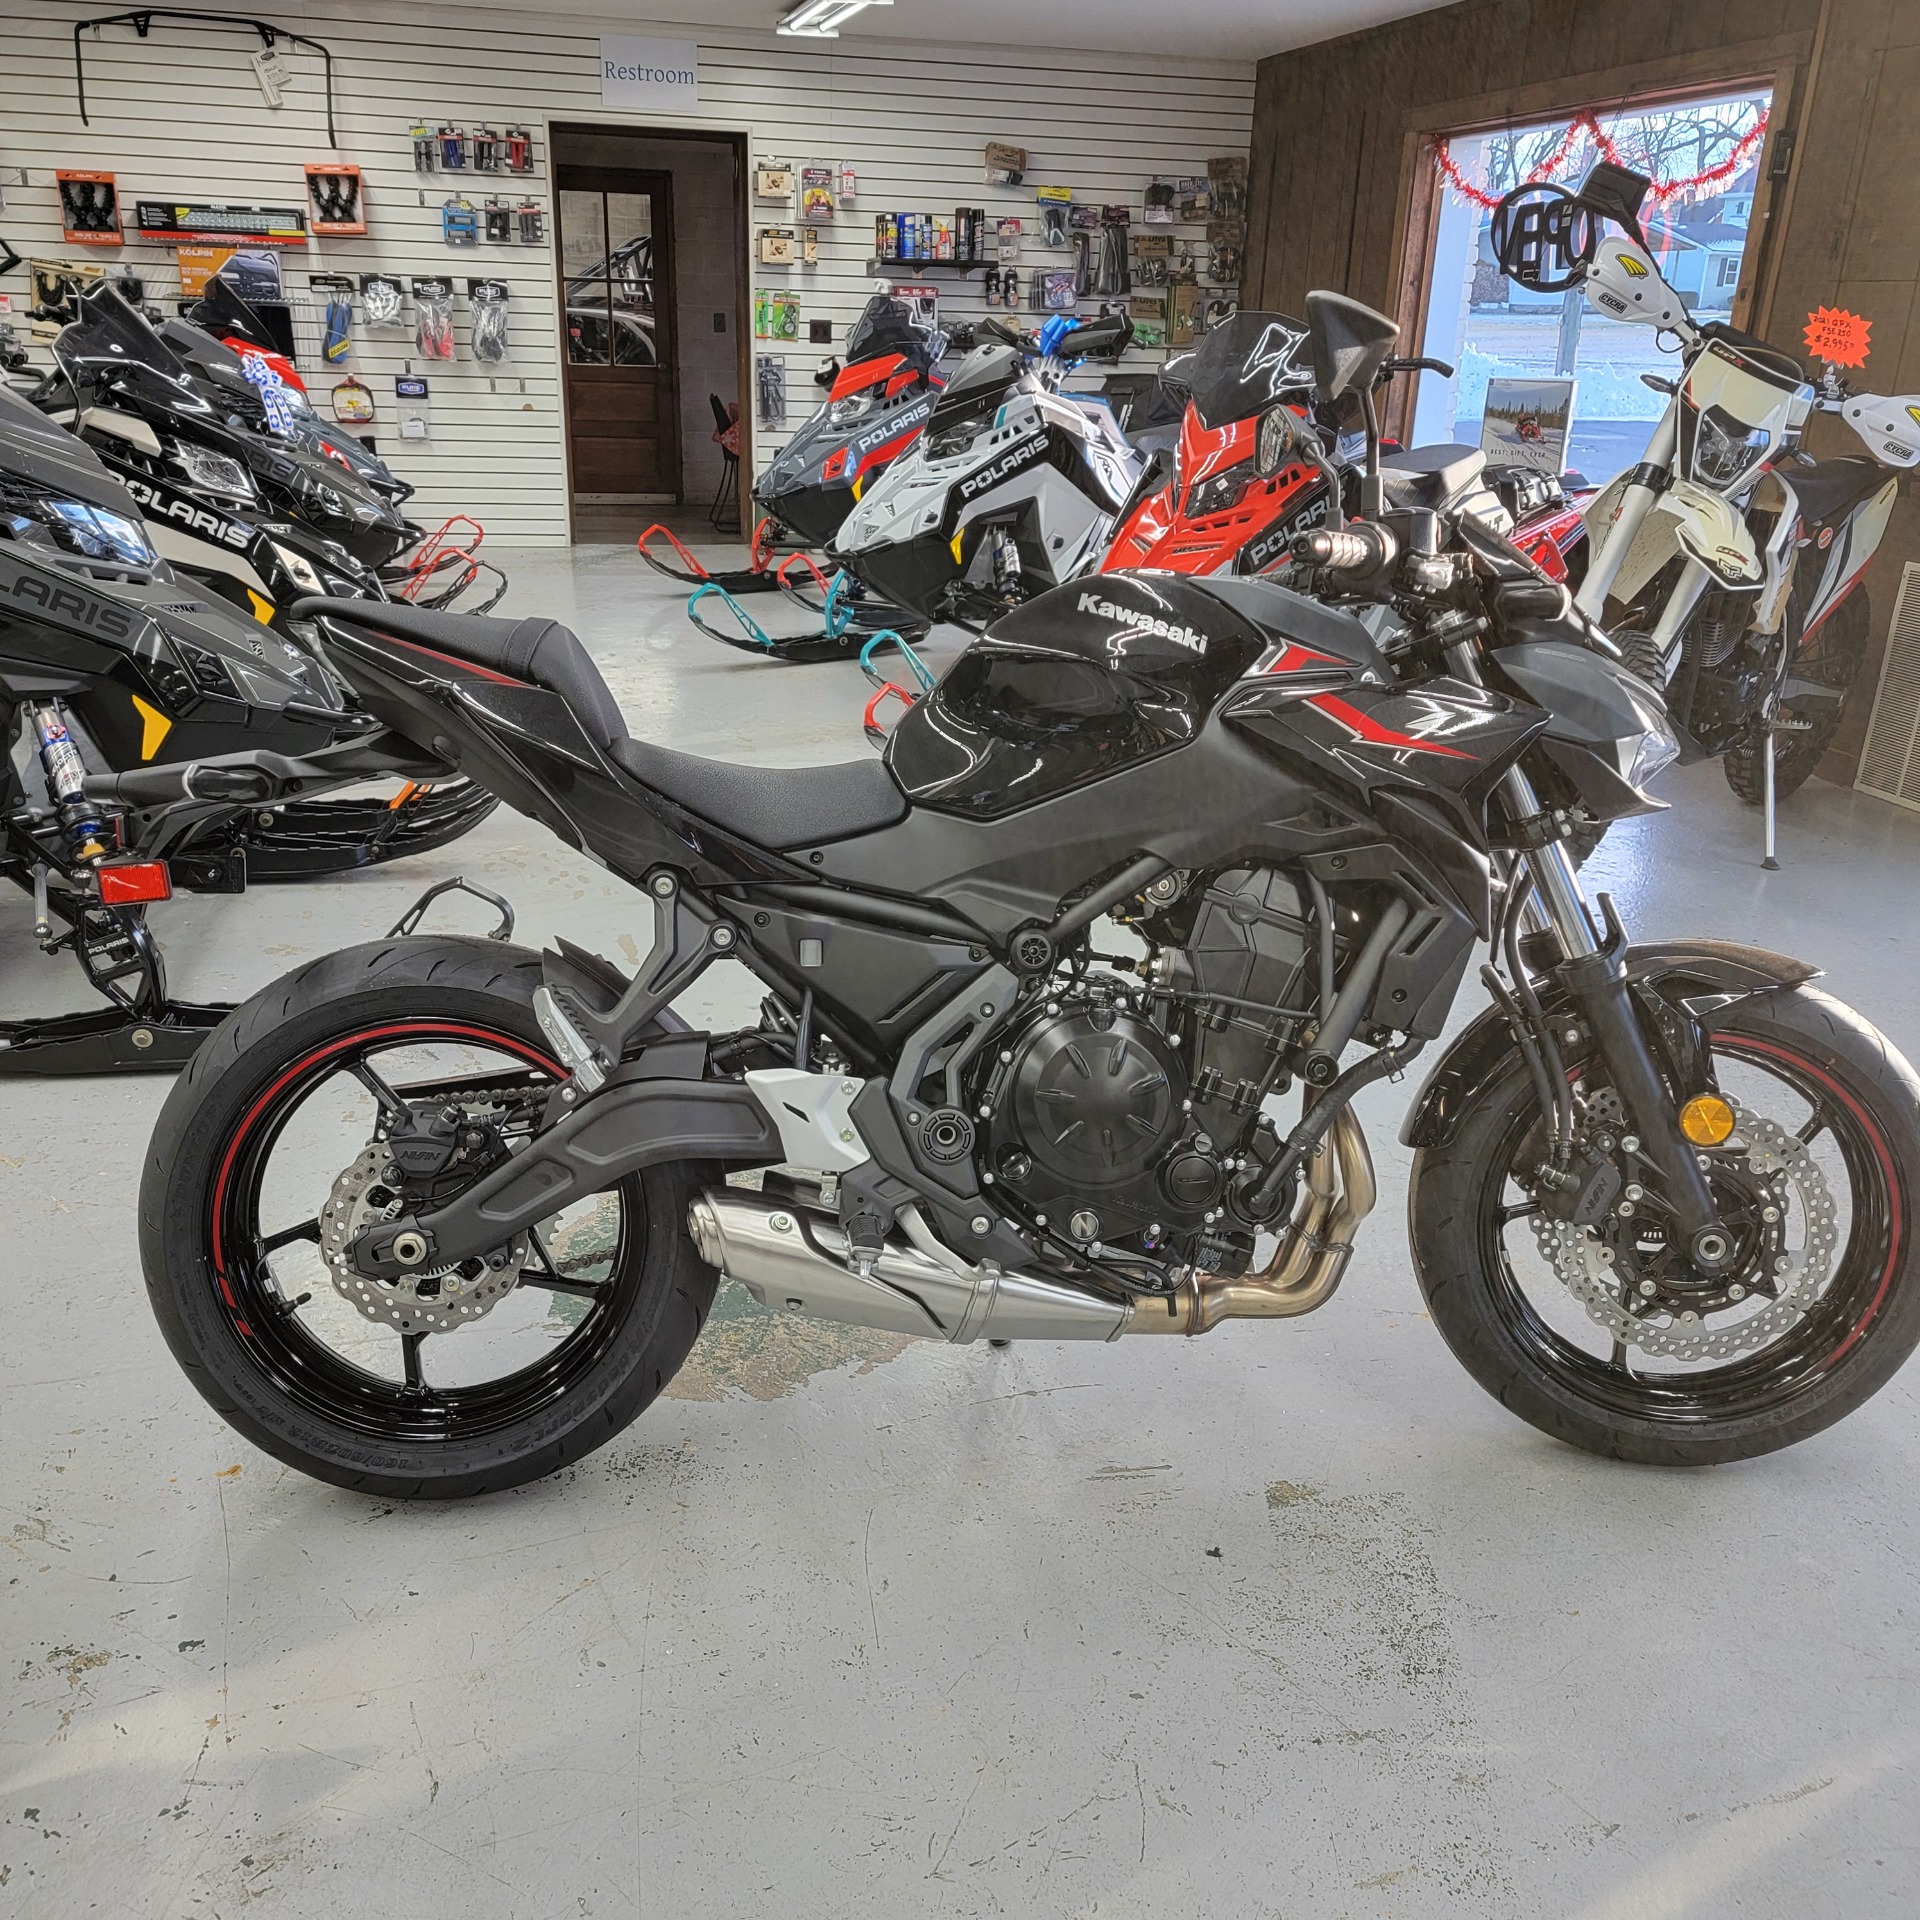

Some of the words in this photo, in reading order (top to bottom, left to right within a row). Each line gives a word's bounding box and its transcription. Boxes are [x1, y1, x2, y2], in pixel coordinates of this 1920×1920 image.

[603, 59, 695, 87] Restroom
[178, 248, 214, 257] KOLPIN
[1600, 293, 1627, 313] CYCRA
[1813, 316, 1829, 324] 2021
[1822, 326, 1835, 335] FSE
[1837, 329, 1851, 337] 250
[1713, 346, 1745, 367] GPX
[858, 402, 931, 452] POLARIS
[1885, 442, 1914, 460] CYCRA
[960, 434, 1049, 498] POLARIS
[1250, 489, 1346, 565] POLARI
[1077, 592, 1208, 654] Kawasaki
[88, 937, 130, 955] POLARIS
[399, 1150, 443, 1162] NISSIN
[1585, 1177, 1608, 1217] NISSIN
